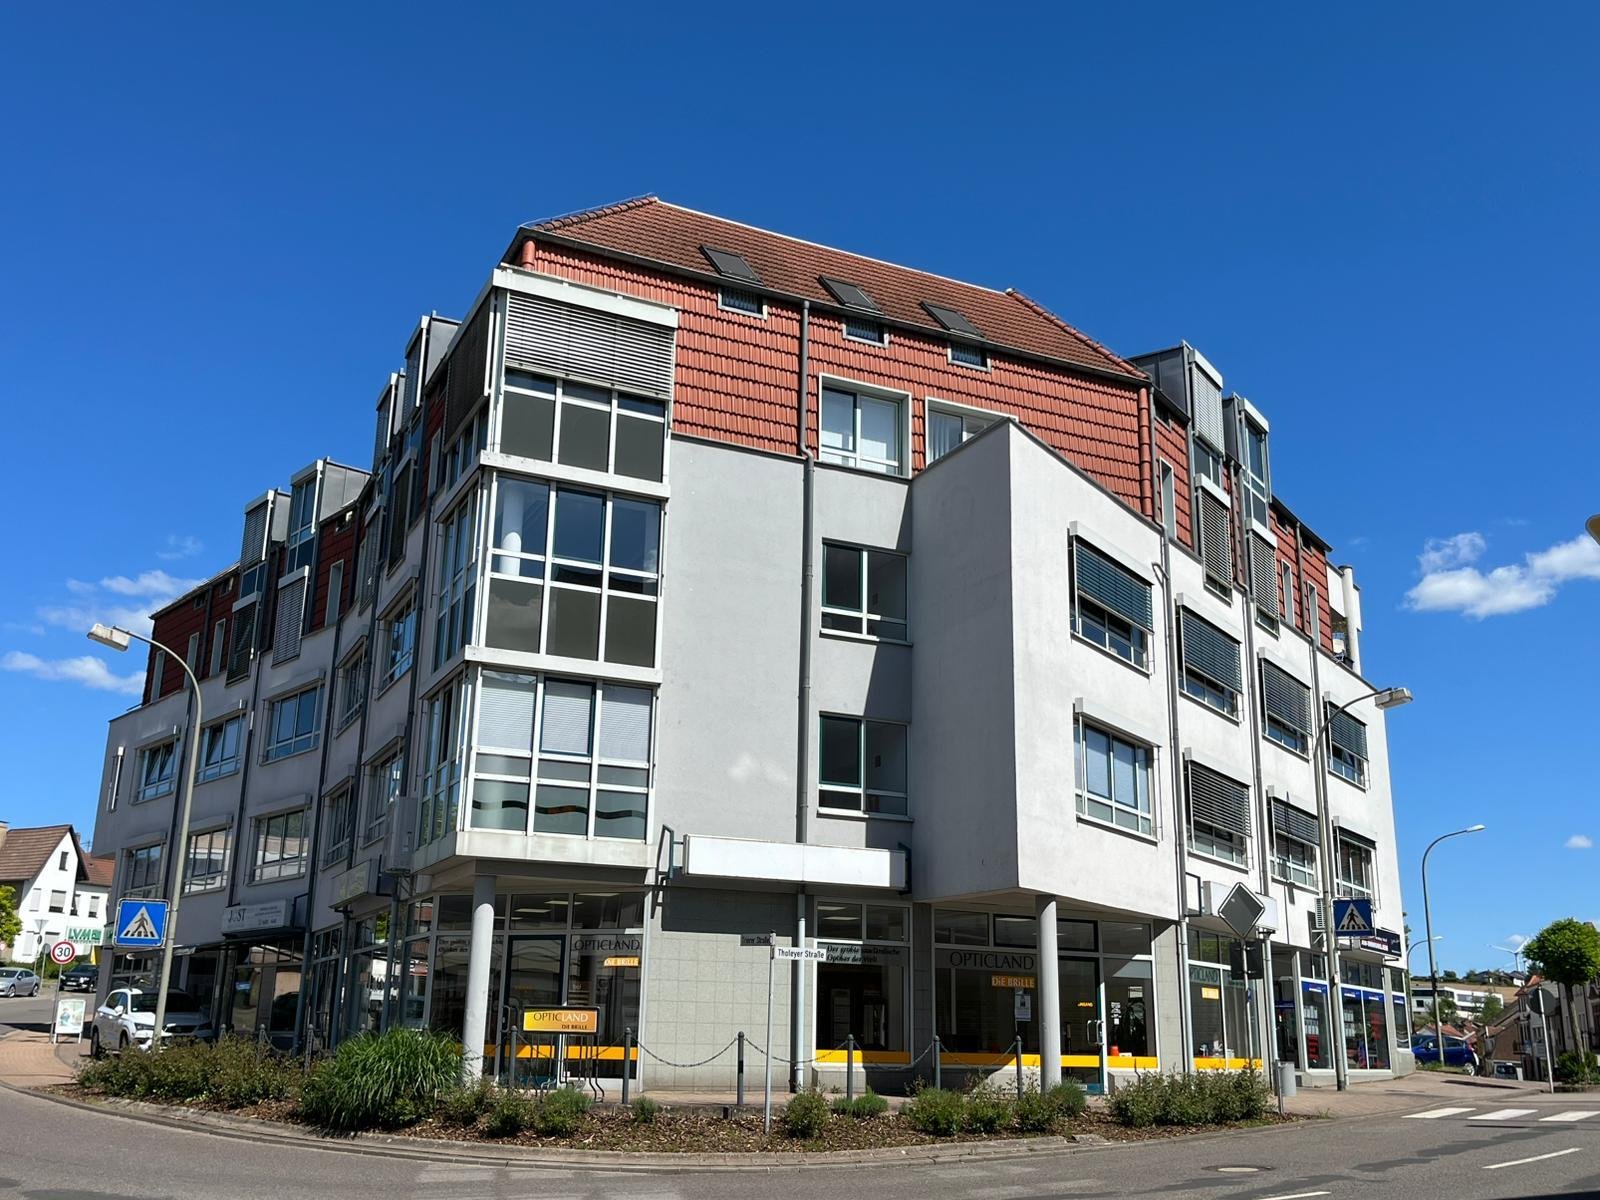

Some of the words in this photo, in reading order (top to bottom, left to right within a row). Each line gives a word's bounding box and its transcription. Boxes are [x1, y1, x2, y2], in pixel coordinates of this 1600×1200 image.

[574, 939, 640, 951] OPTICLAND
[57, 947, 71, 957] 30
[778, 948, 803, 958] Tholeyer
[804, 950, 825, 959] Straße
[950, 952, 1034, 970] OPTICLAND
[533, 1012, 588, 1022] OPTICLAND
